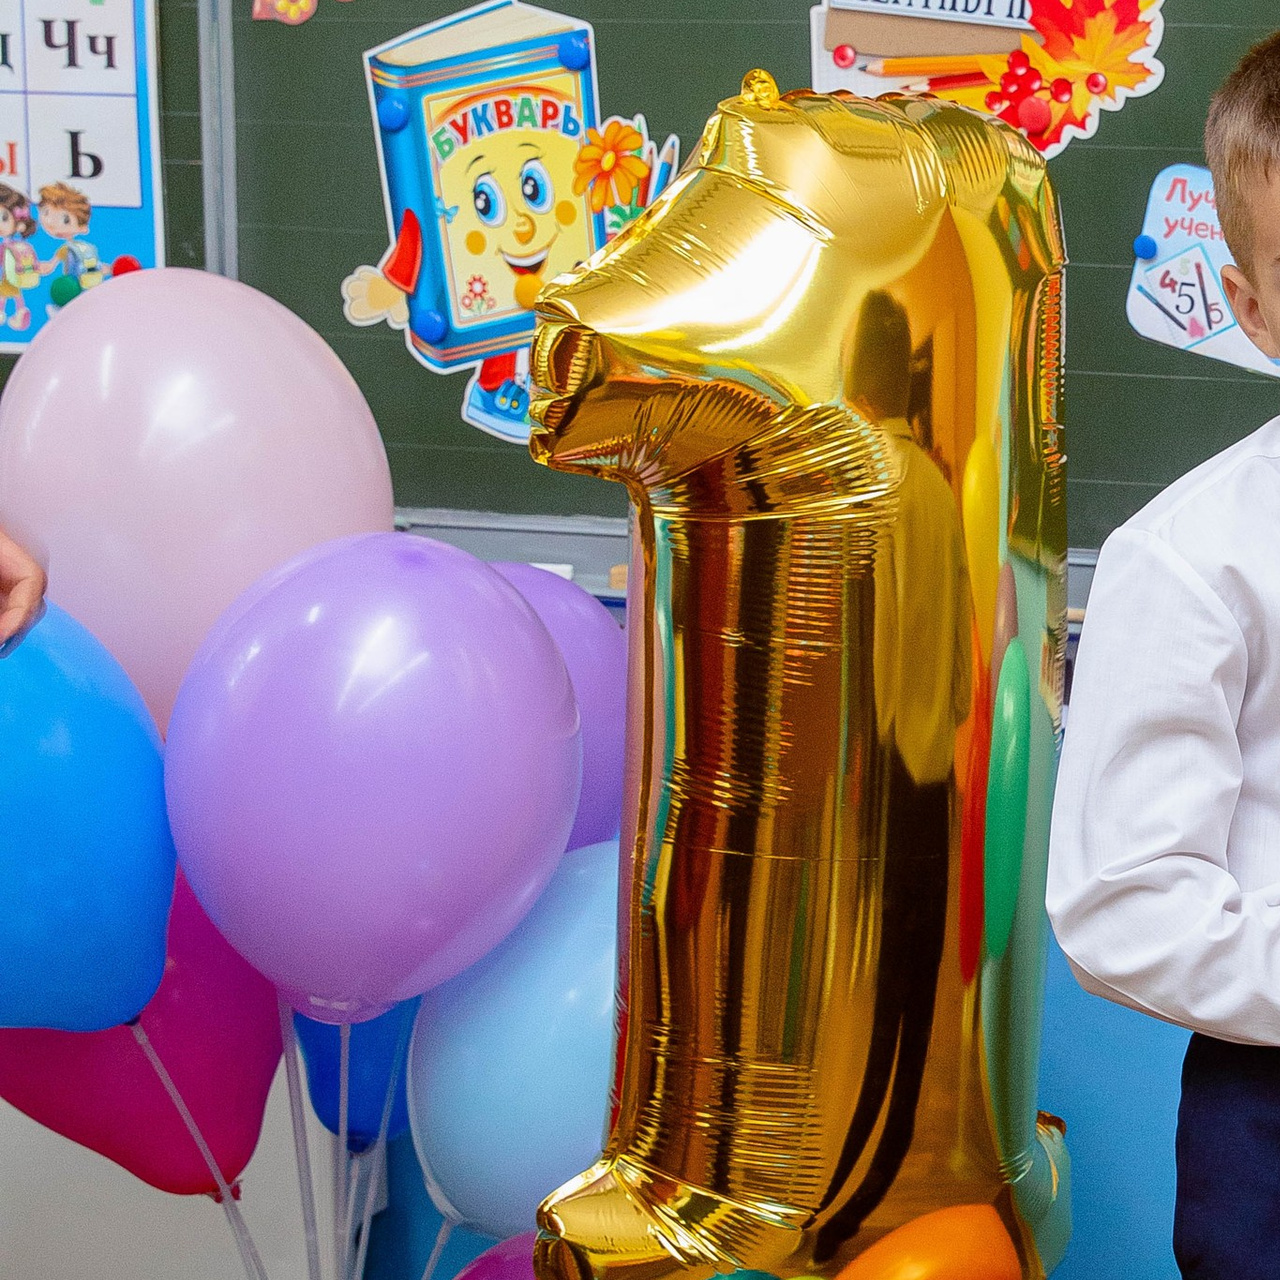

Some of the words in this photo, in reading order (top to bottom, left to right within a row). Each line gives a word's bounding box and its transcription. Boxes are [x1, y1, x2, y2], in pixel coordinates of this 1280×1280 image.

[38, 19, 119, 70] Чч
[431, 96, 582, 160] БУКВАРЬ
[65, 129, 106, 180] Ь
[1174, 281, 1196, 315] 5
